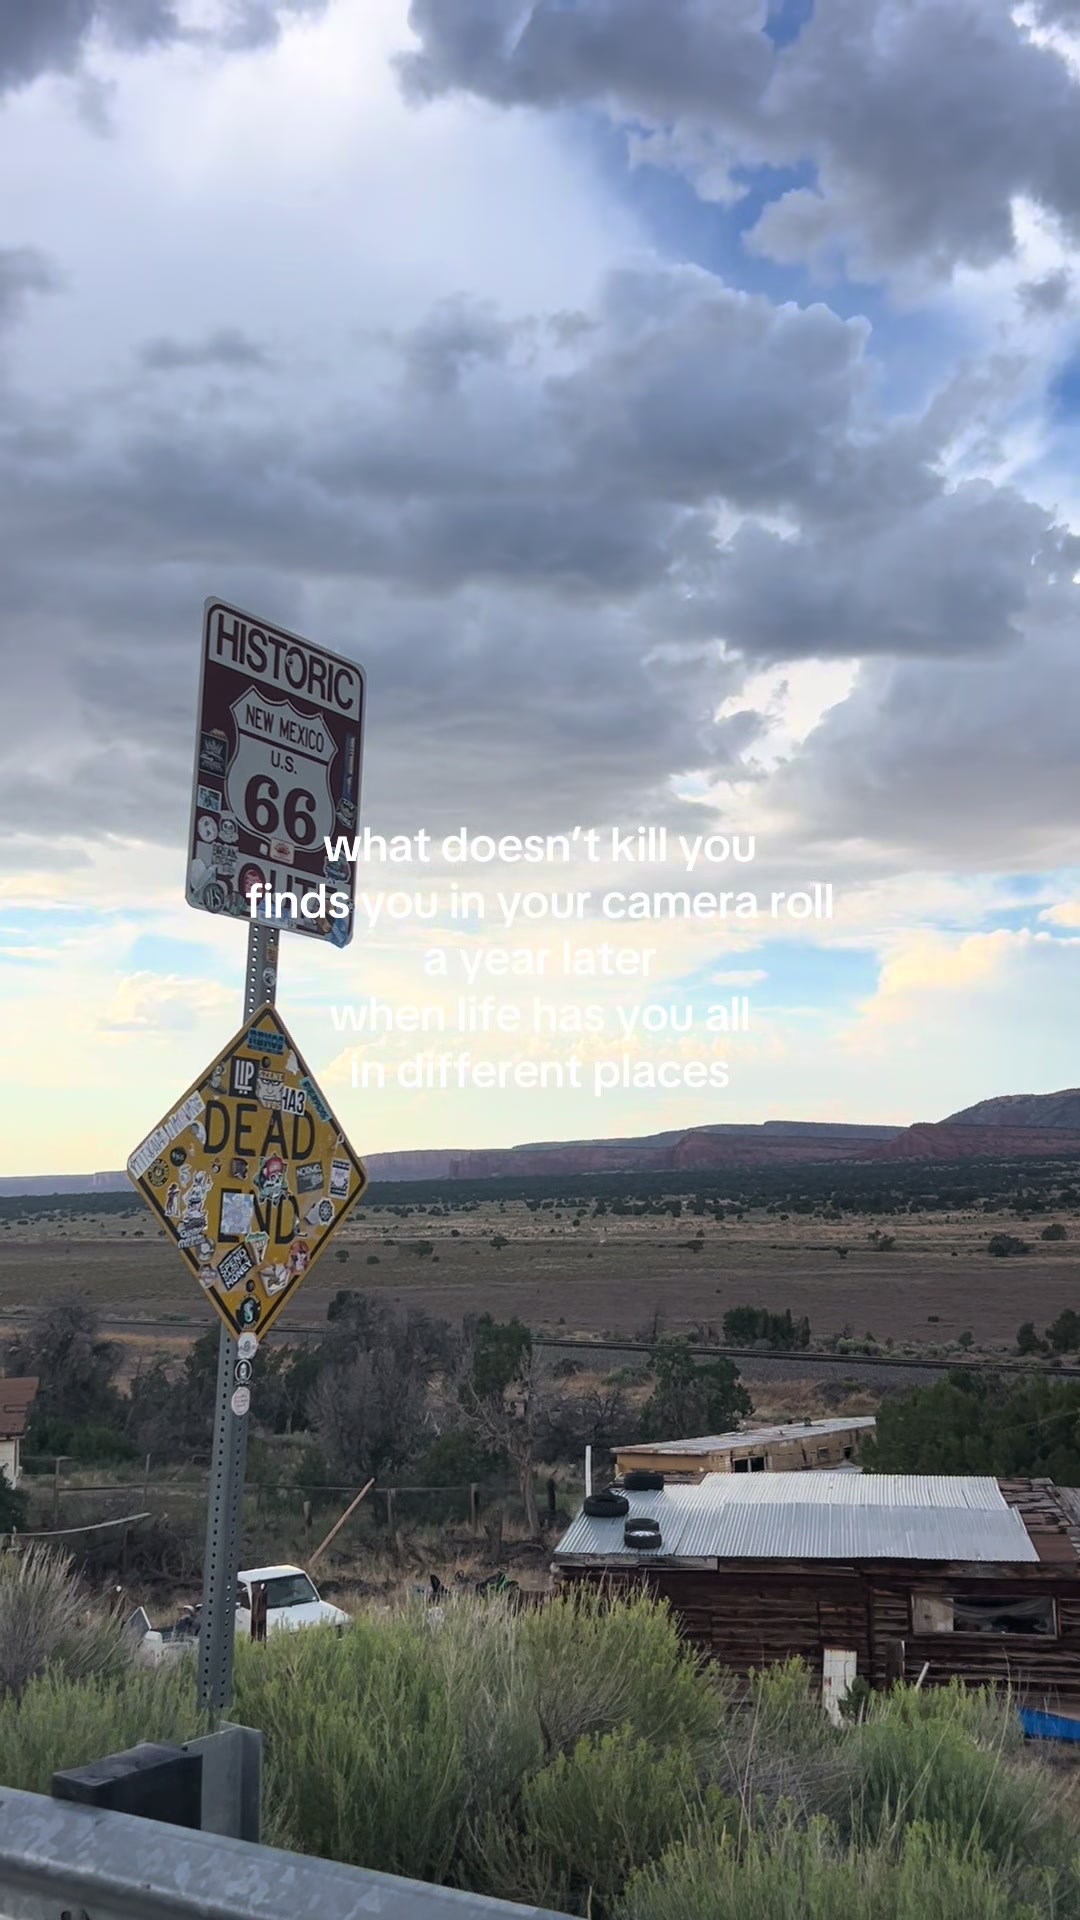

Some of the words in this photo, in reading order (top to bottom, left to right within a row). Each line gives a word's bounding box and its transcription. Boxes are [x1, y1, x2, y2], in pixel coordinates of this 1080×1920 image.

[216, 613, 354, 710] HISTORIC
[245, 703, 275, 733] NEW
[279, 717, 325, 753] MEXICO
[271, 750, 298, 775] U.S.
[244, 774, 317, 846] 66
[203, 1101, 316, 1161] DEAD
[226, 1260, 252, 1289] MONEY
